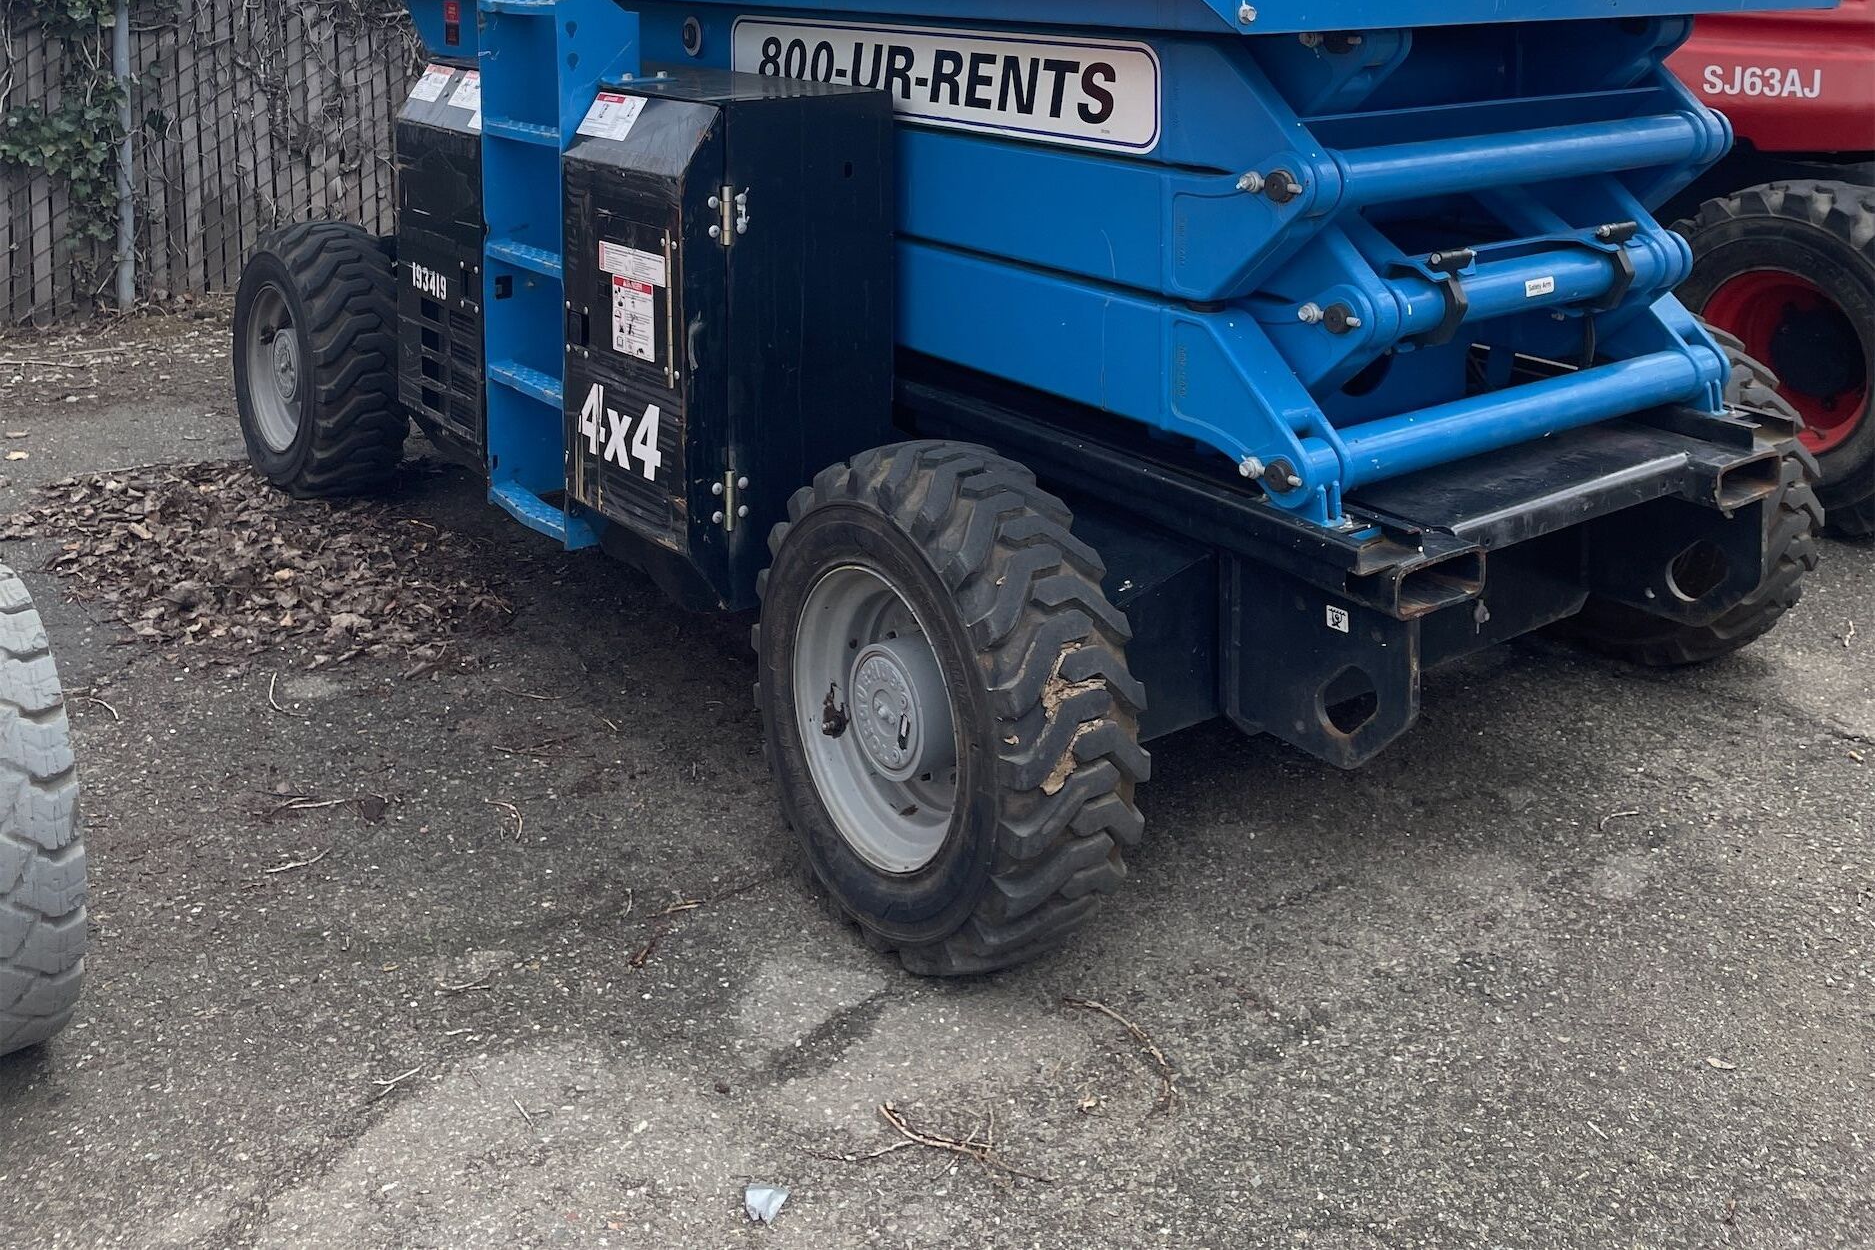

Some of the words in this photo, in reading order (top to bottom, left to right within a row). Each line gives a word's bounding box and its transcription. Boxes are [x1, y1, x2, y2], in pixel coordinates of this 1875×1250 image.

[758, 36, 1117, 125] 800-UR-RENTS
[1703, 65, 1822, 99] SJ63AJ
[412, 261, 447, 301] 193419
[580, 382, 662, 482] 4x4
